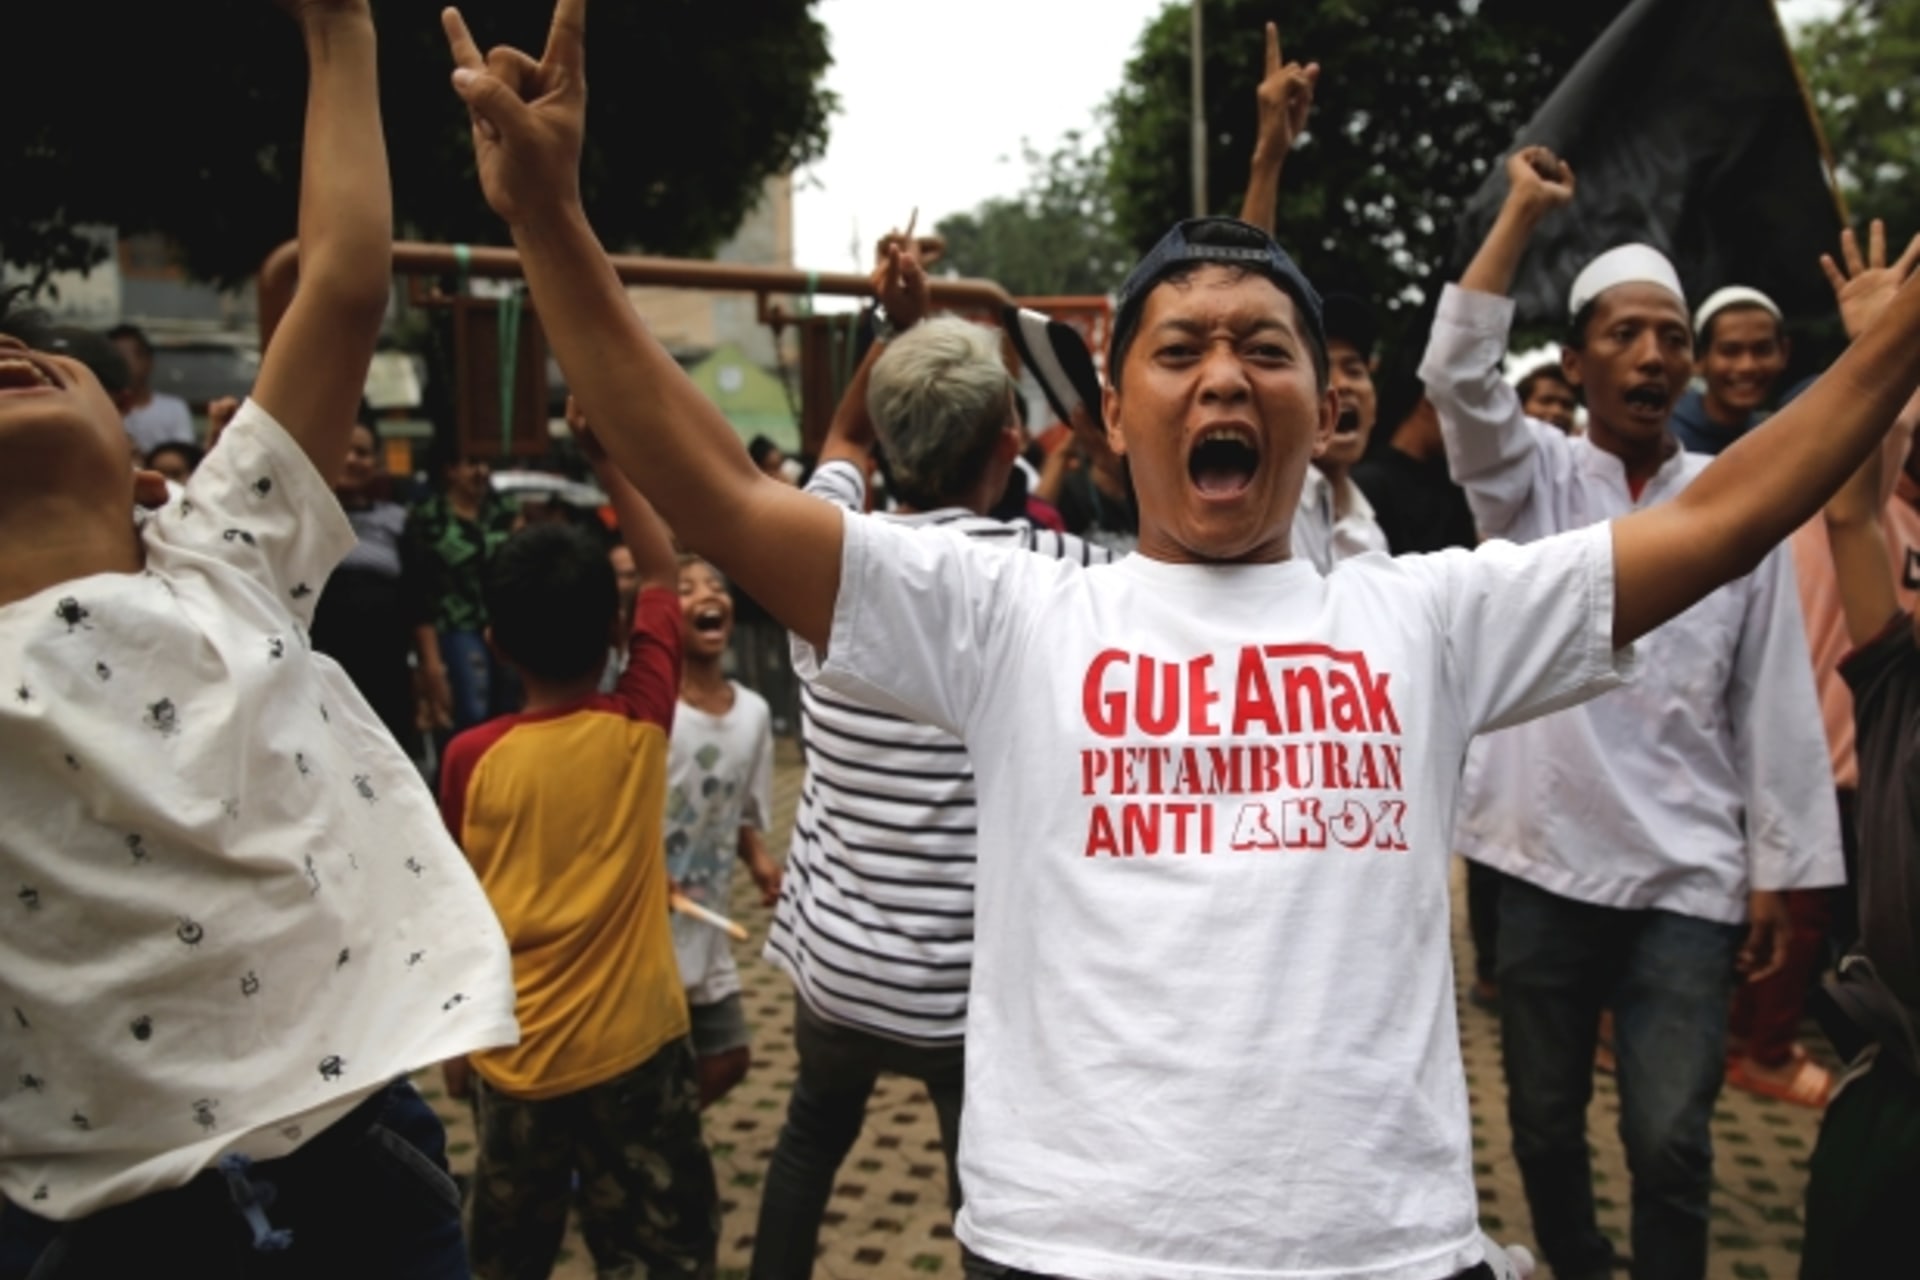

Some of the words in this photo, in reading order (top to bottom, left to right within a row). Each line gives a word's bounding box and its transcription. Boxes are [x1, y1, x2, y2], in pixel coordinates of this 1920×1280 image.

[1082, 648, 1220, 737] GUE
[1232, 642, 1401, 735] Anak
[1081, 742, 1403, 795] PETAMBURAN
[1085, 803, 1213, 857] ANTI
